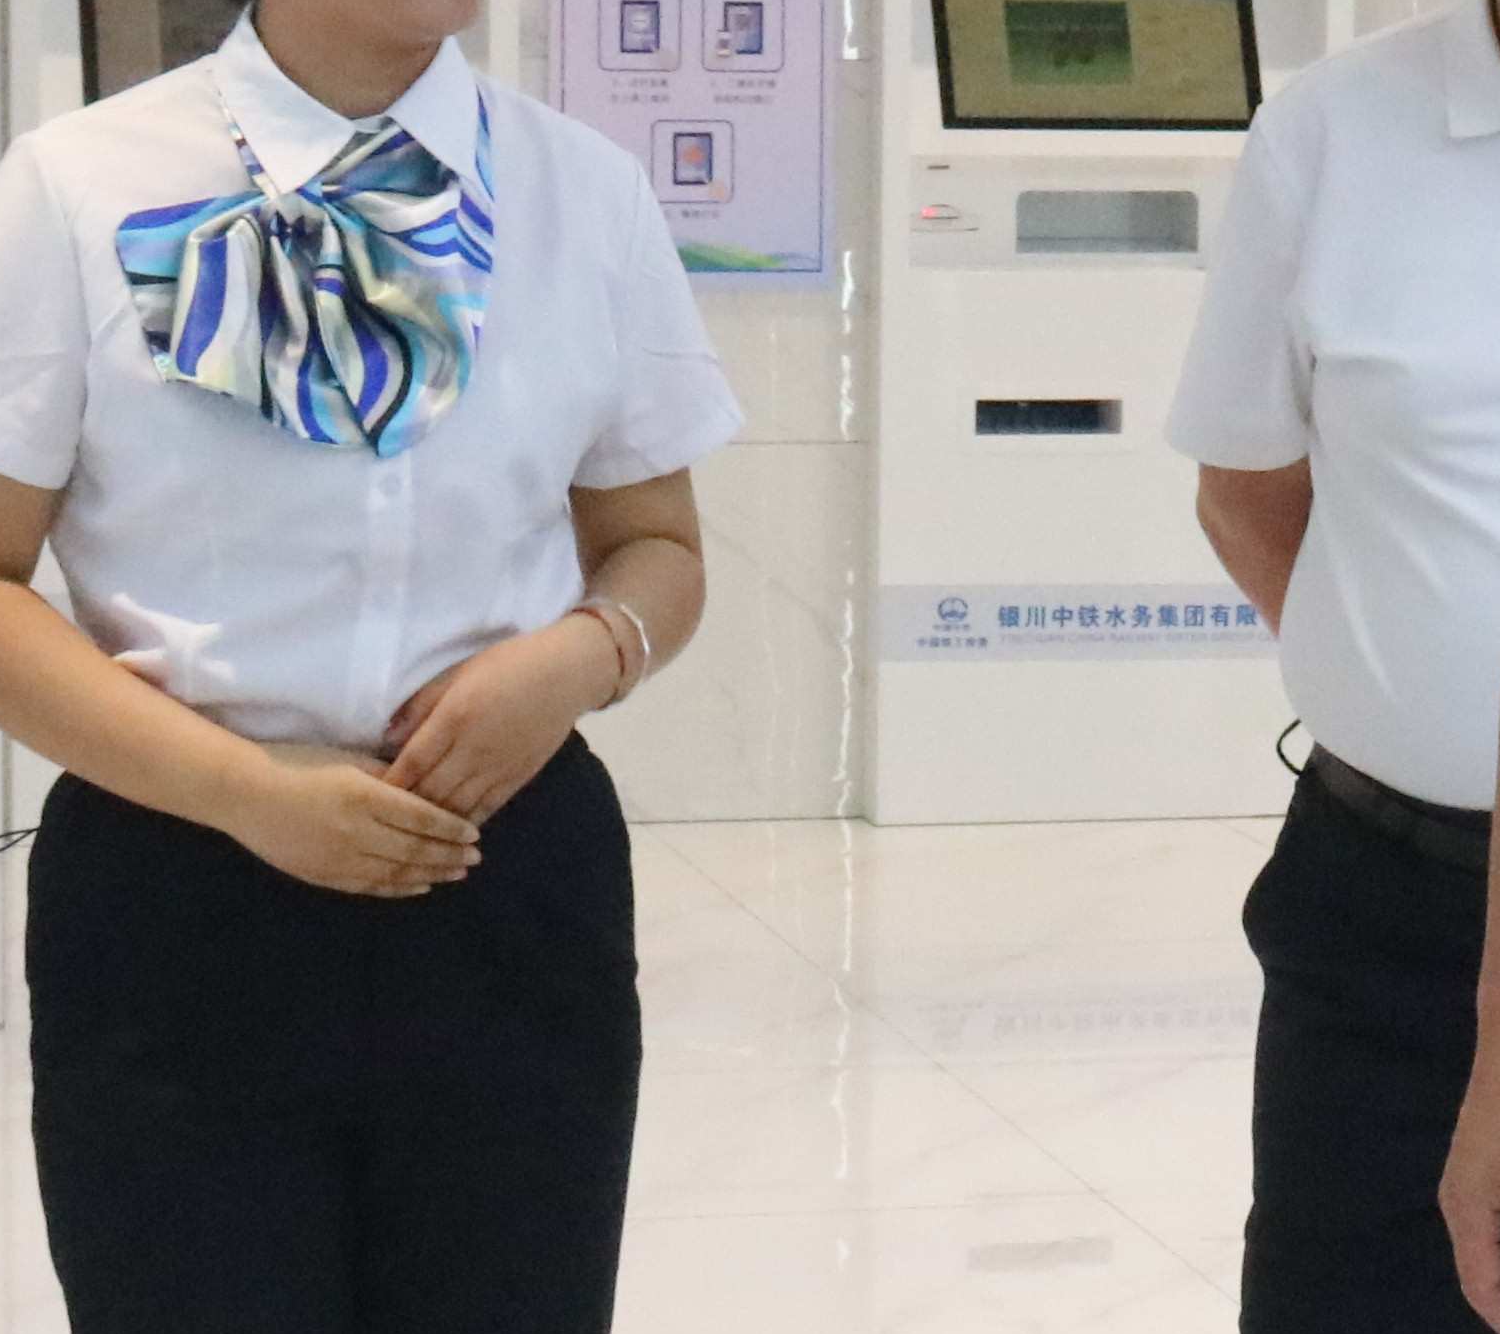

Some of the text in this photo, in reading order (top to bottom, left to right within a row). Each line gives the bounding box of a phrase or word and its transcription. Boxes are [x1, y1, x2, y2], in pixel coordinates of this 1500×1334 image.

[998, 604, 1259, 629] 银川中铁水务集团有限
